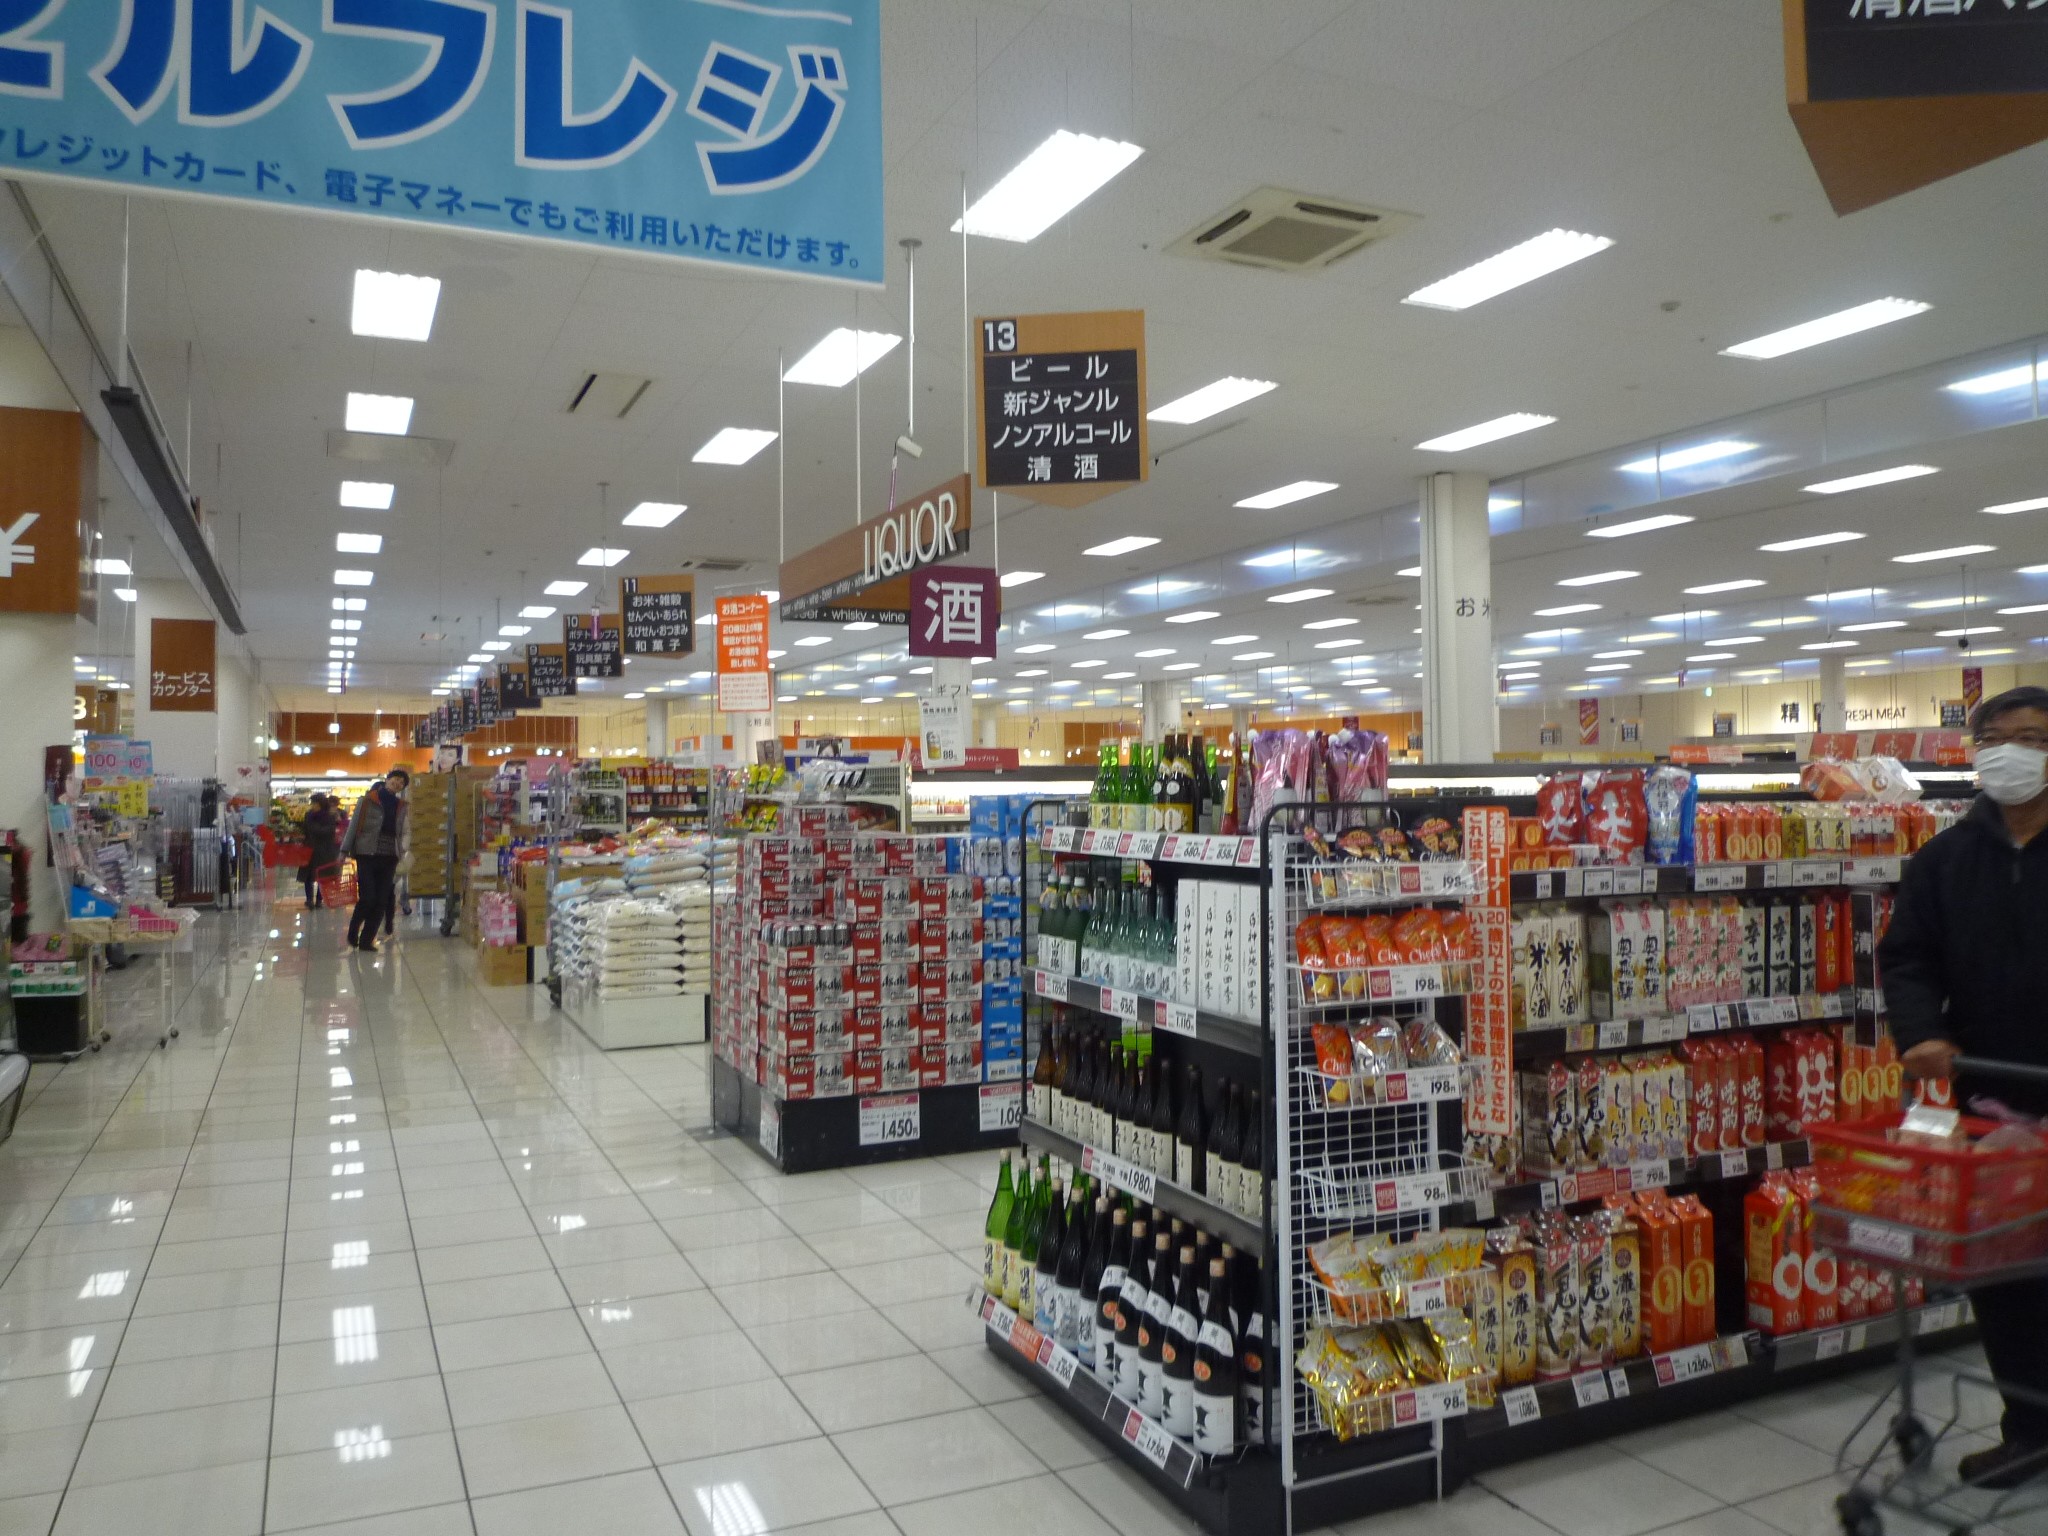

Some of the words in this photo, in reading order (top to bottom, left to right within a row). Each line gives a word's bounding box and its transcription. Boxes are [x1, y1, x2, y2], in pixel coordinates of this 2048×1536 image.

[0, 128, 297, 196] レジットカード、
[984, 322, 1015, 352] 13
[1003, 387, 1119, 417] 新ジャンル
[993, 419, 1132, 449] ノンアルコール
[864, 491, 958, 584] LIQUOR
[623, 578, 637, 593] 11
[632, 594, 682, 608] お米・雑穀
[721, 602, 764, 616] お酒コーナー
[831, 608, 867, 622] whisky
[880, 611, 906, 623] wine
[924, 578, 984, 644] 酒
[567, 616, 578, 628] 10
[626, 611, 688, 623] せんべい・あられ
[569, 629, 619, 640] ポテトップス
[626, 624, 688, 638] えびせん・おつまみ
[568, 642, 619, 652] スナック菓子
[635, 639, 681, 653] 和菓子
[531, 657, 563, 665] チョコレ
[152, 671, 210, 685] サービス
[534, 668, 563, 676] ビスケッ
[152, 684, 211, 697] カウンター
[1845, 708, 1873, 721] RESH
[1876, 706, 1907, 719] MEAT
[1488, 810, 1507, 906] お酒コーナー
[1415, 977, 1441, 991] 198円
[1430, 1080, 1456, 1094] 198円
[1000, 1106, 1021, 1128] 1,06
[882, 1118, 919, 1140] 1,450円
[1424, 1187, 1446, 1201] 98円
[1425, 1297, 1445, 1312] 108円
[1443, 1396, 1466, 1411] 98円
